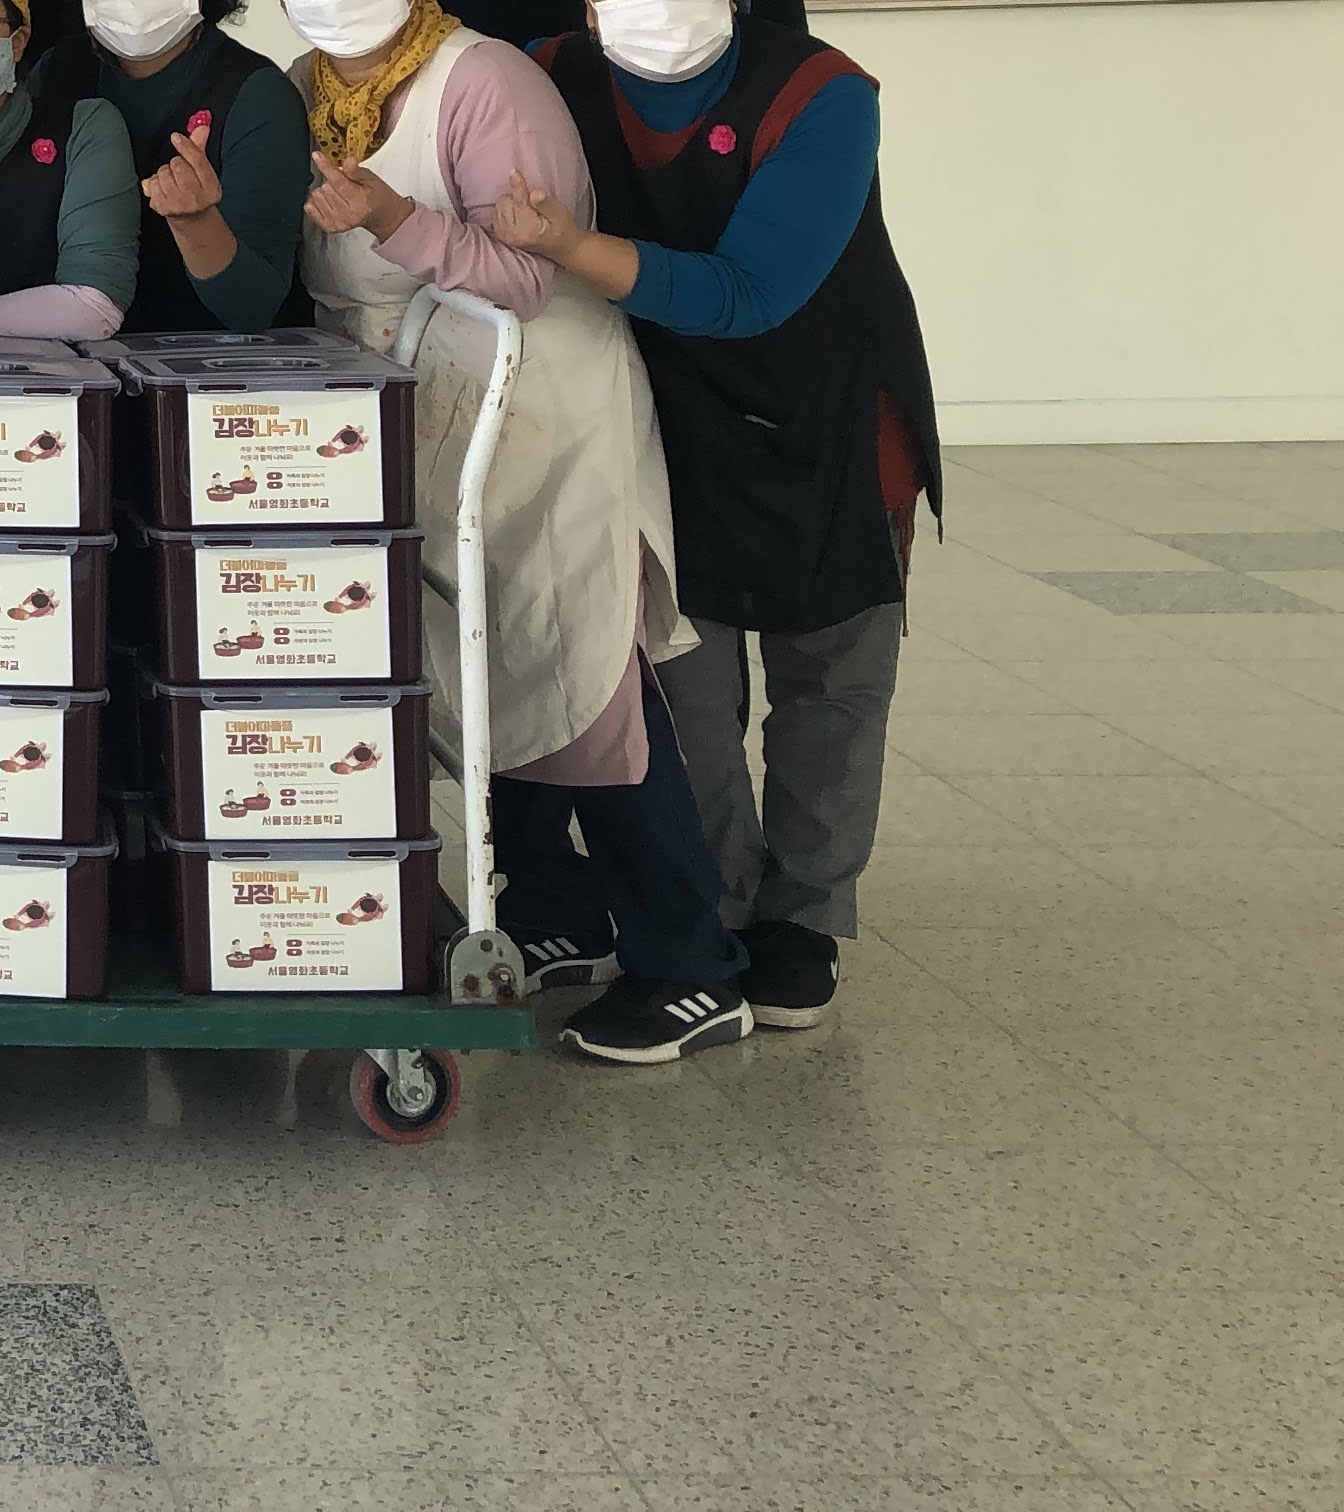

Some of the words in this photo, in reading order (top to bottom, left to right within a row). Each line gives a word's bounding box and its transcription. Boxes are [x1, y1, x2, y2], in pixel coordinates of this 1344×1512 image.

[212, 416, 309, 438] 김장나누기
[219, 571, 316, 593] 김장나누기
[225, 733, 322, 755] 김장나누기
[232, 883, 328, 905] 김장나누기
